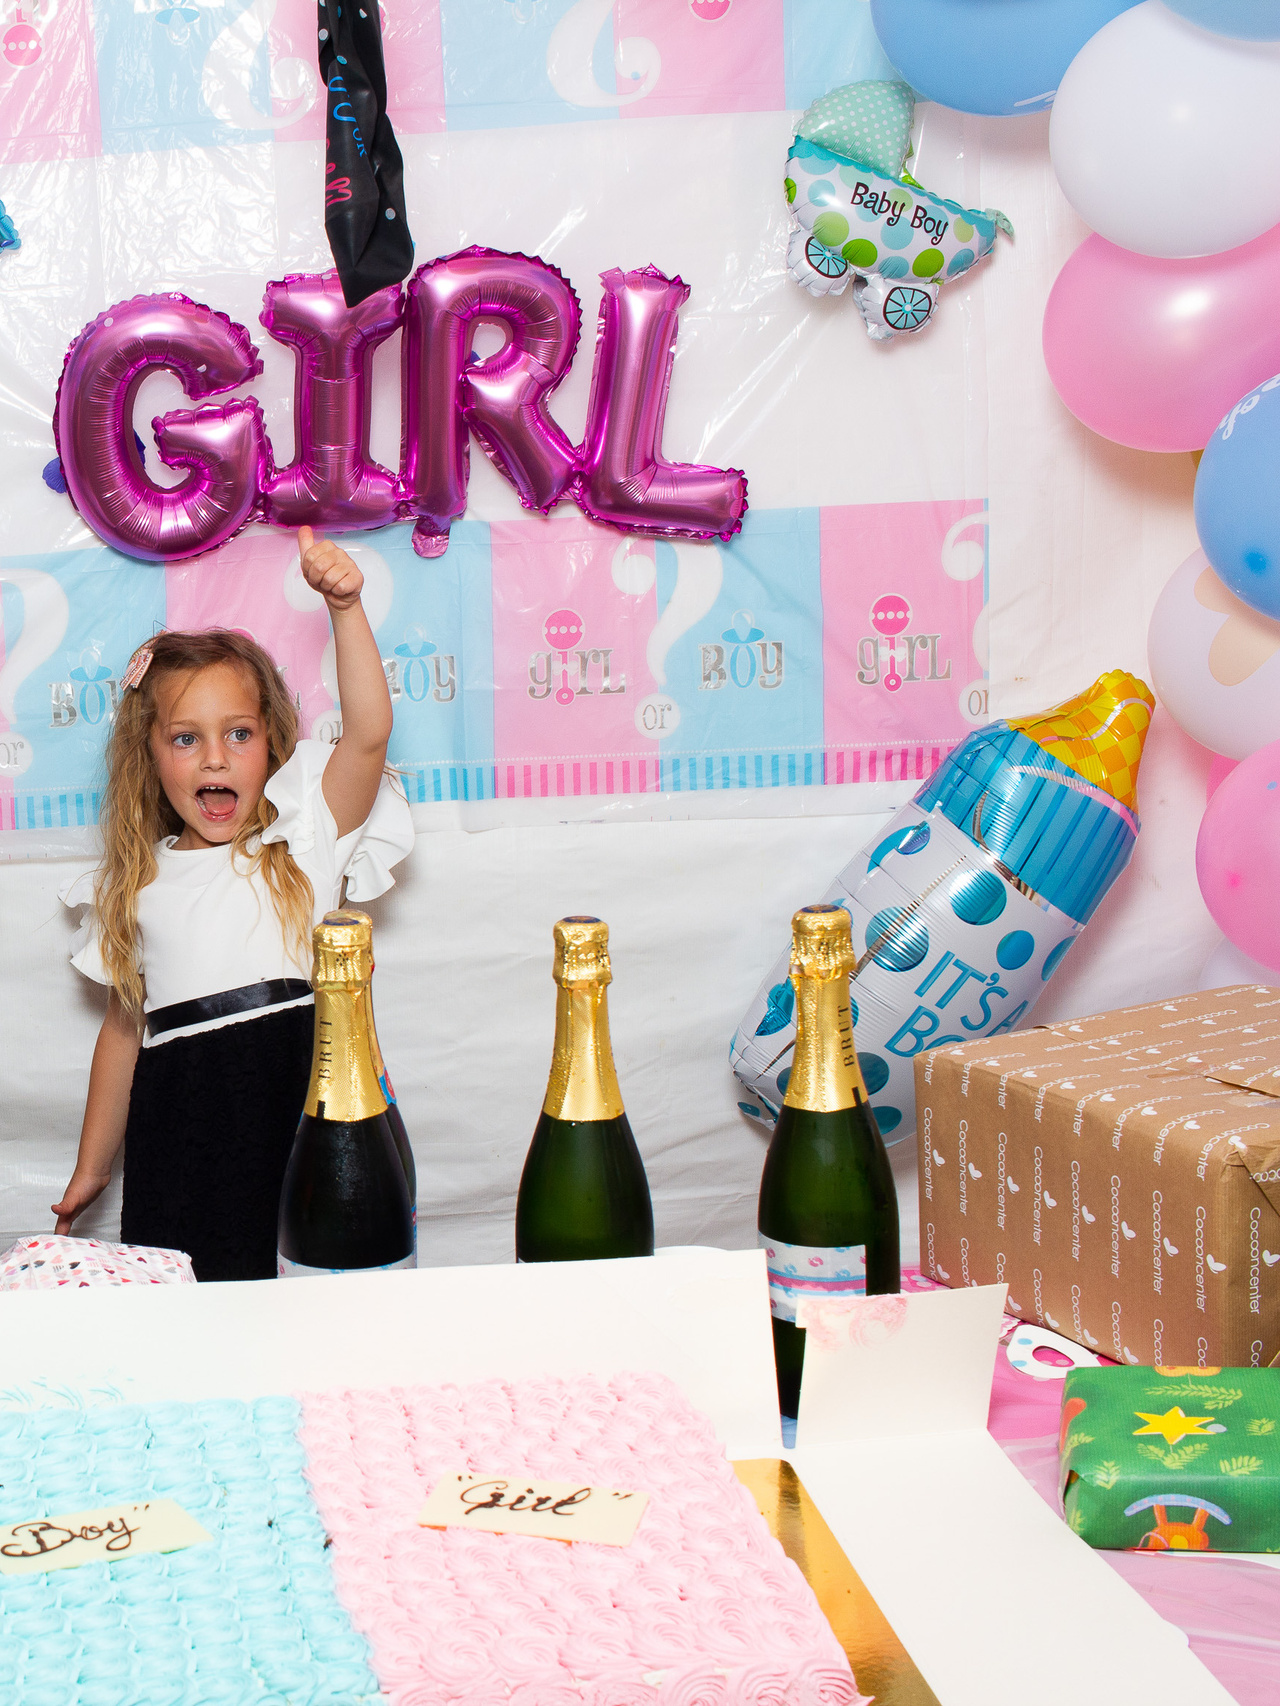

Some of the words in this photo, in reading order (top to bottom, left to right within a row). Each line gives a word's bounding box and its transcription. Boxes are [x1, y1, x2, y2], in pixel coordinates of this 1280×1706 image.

[850, 181, 906, 226] Baby
[909, 204, 949, 246] Boy
[56, 245, 749, 558] GIRL
[642, 703, 672, 731] or
[837, 1004, 855, 1068] BRUT
[914, 950, 1009, 1031] IT'S
[318, 1016, 333, 1080] BRUT
[923, 1107, 933, 1202] Cocooncenter
[958, 1119, 969, 1217] Cocooncenter
[997, 1132, 1008, 1231] Cocooncenter
[1033, 1146, 1044, 1247] Cocooncenter
[1070, 1160, 1081, 1262] Cocooncenter
[1110, 1174, 1121, 1279] Cocooncenter
[1152, 1190, 1164, 1296] Cocooncenter
[1194, 1206, 1207, 1314] Cocooncenter
[1248, 1207, 1262, 1315] Cocooncenter
